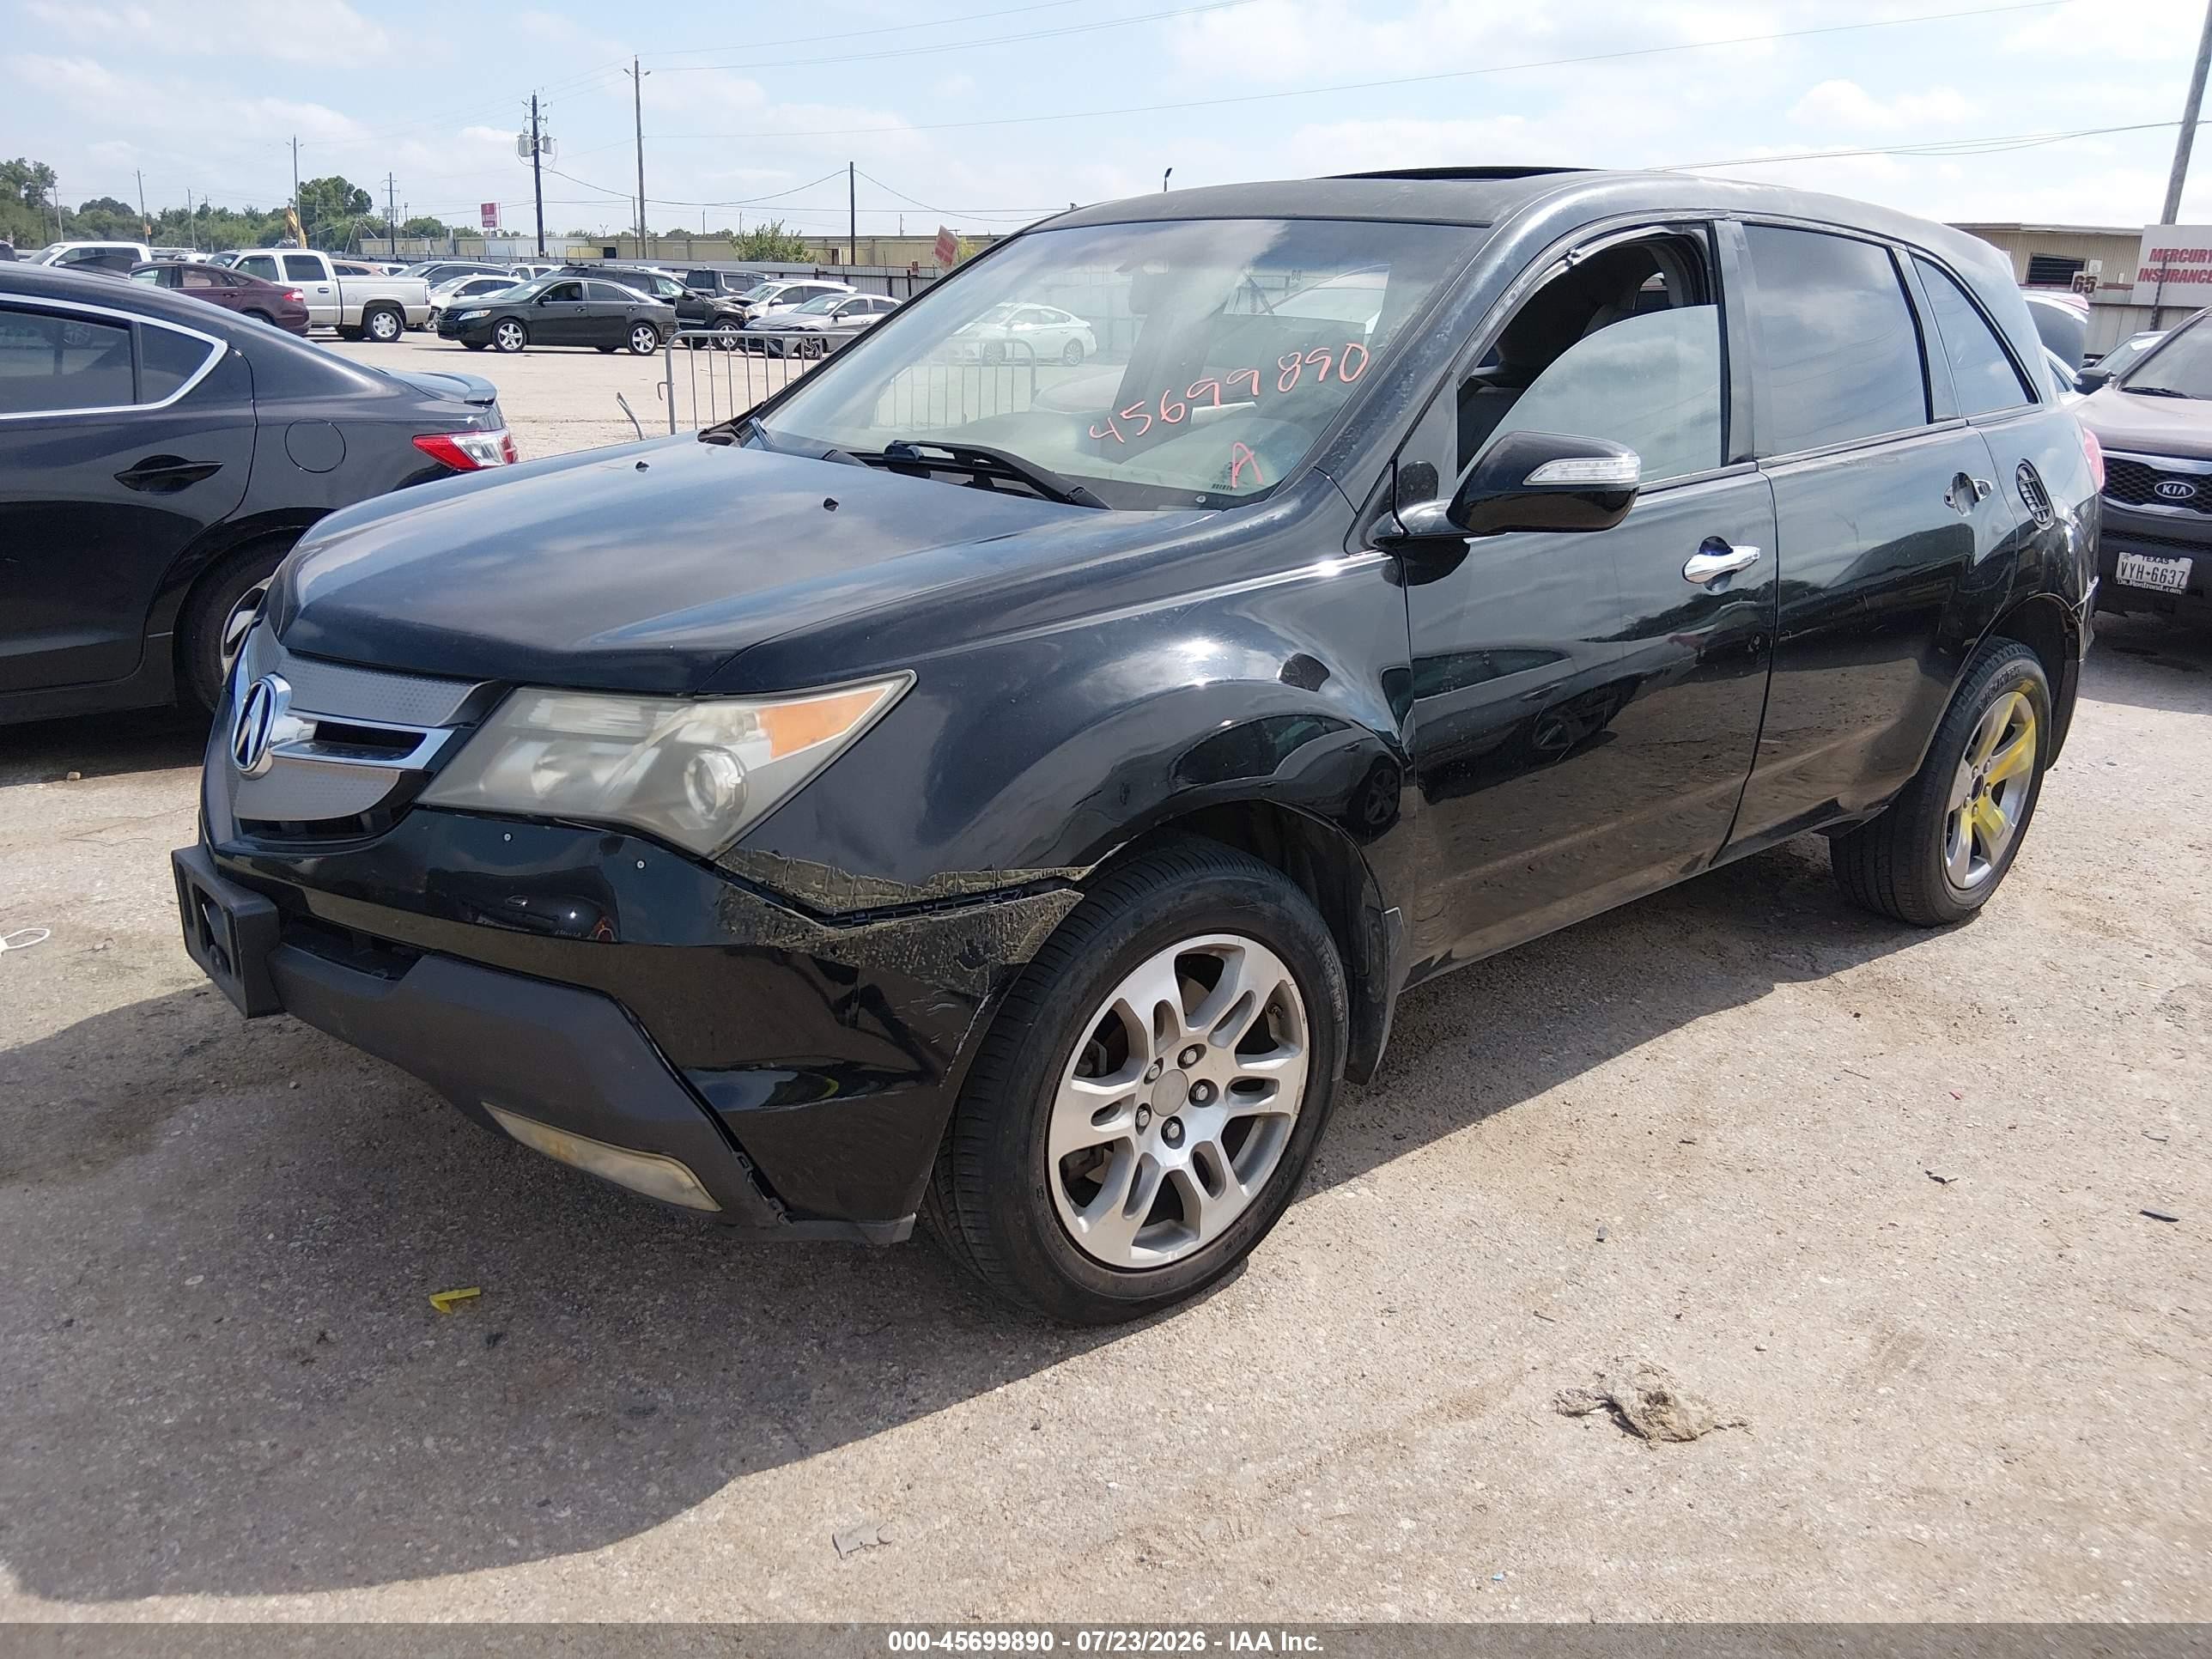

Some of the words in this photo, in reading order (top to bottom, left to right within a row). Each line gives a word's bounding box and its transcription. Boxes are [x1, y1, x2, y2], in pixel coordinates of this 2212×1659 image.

[2137, 268, 2212, 283] INSURANCE
[2072, 276, 2098, 294] 65
[1231, 441, 1265, 489] A
[2161, 484, 2186, 495] KIA
[2142, 556, 2169, 565] TEXAS
